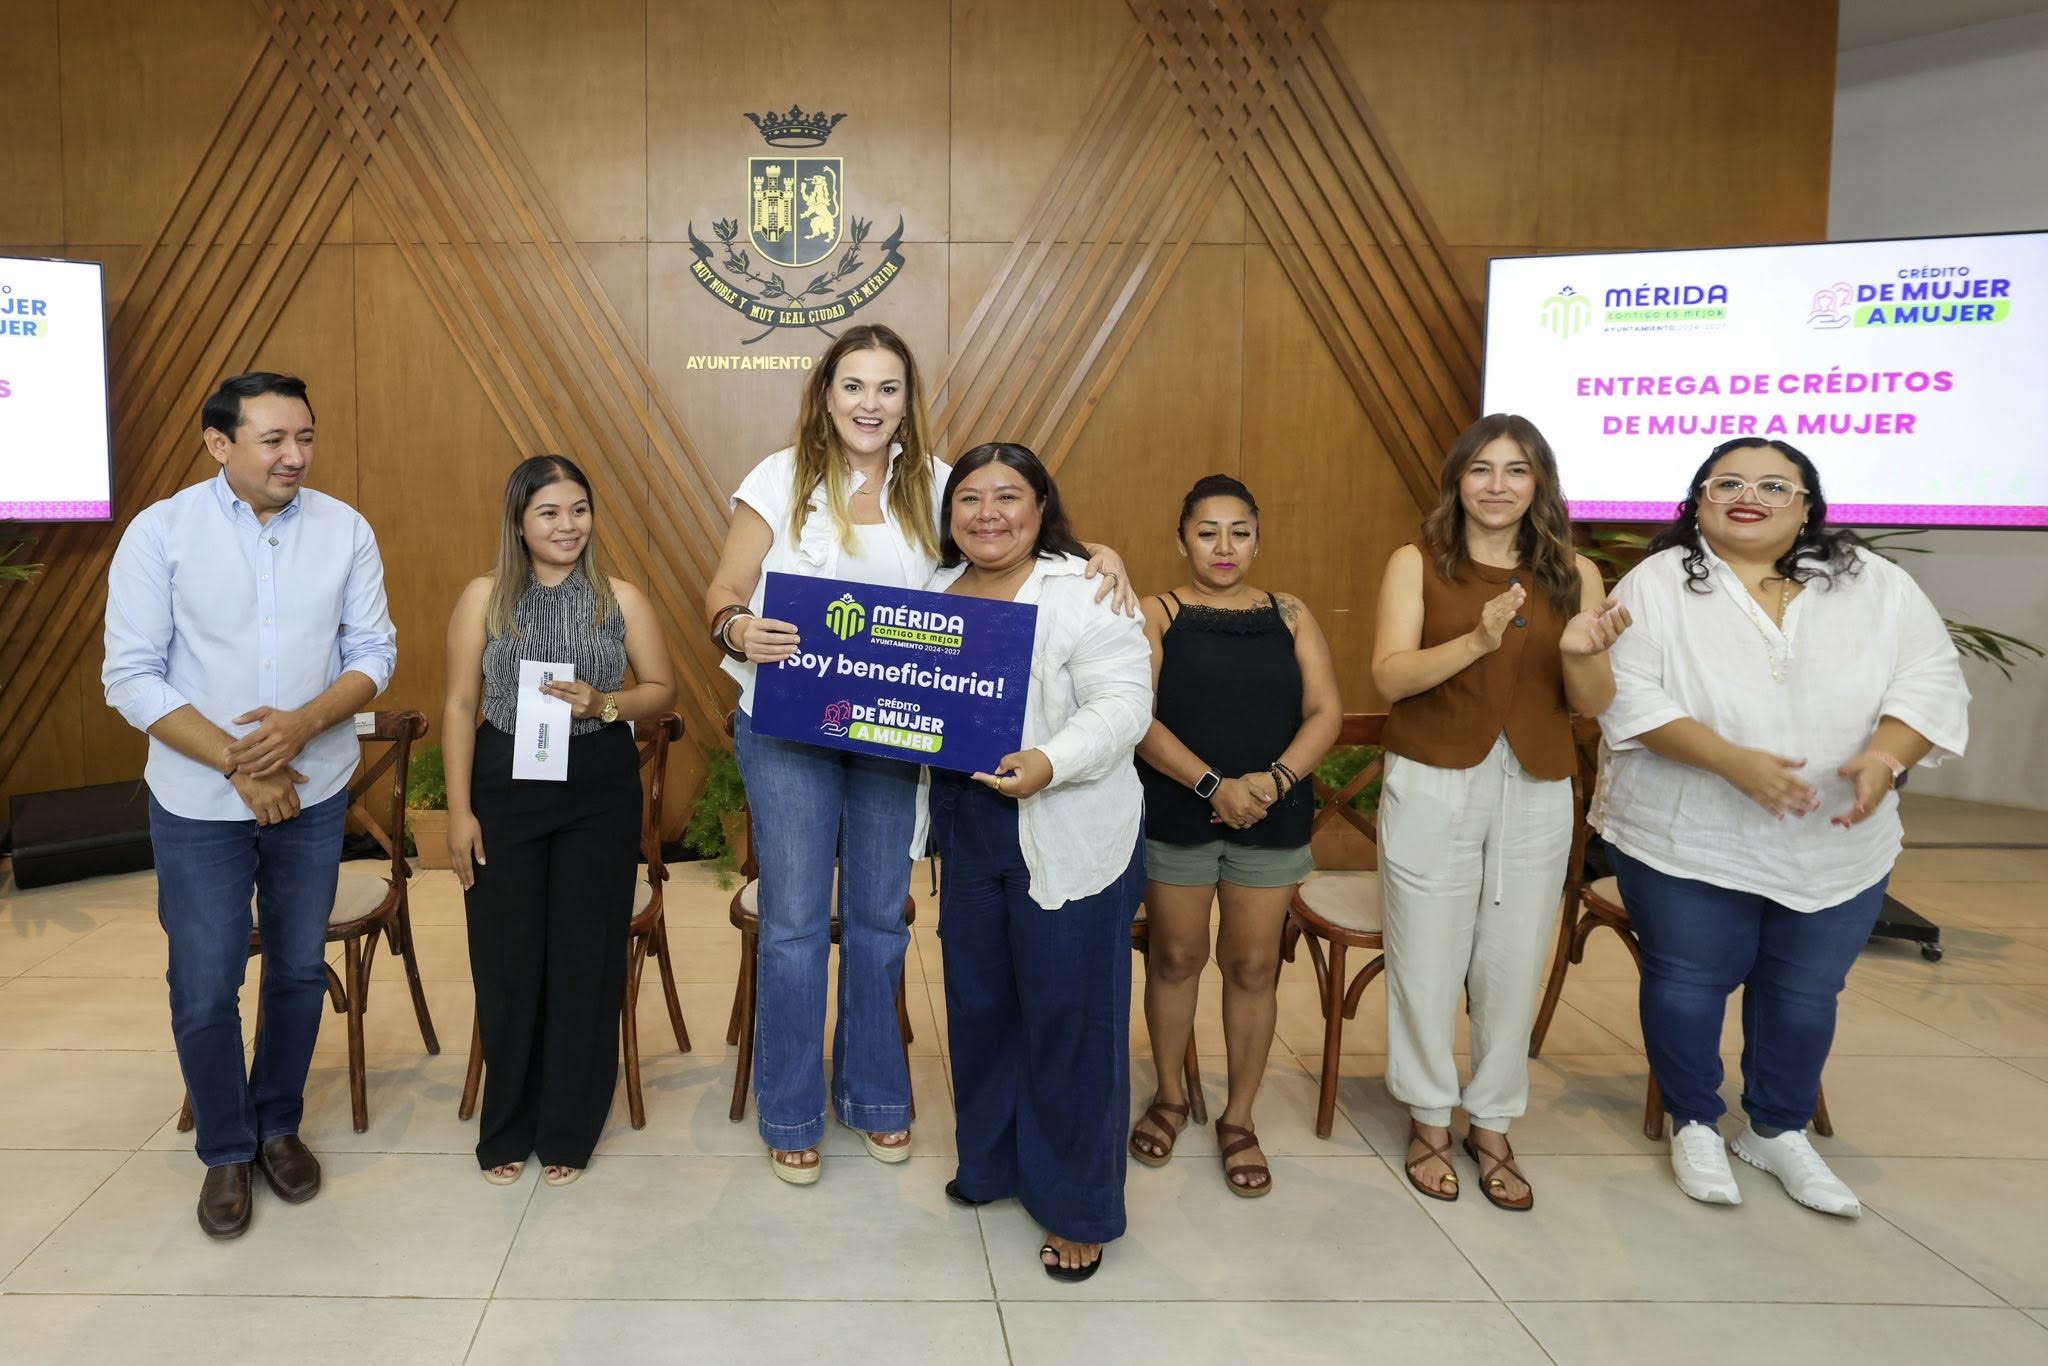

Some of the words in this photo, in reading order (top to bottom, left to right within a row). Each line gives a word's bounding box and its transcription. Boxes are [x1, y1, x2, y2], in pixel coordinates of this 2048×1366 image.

[1898, 266, 1970, 279] CRÉDITO
[692, 260, 714, 282] MUY
[709, 278, 738, 304] NOBLE
[738, 296, 748, 308] Y
[750, 305, 775, 322] MUY
[780, 311, 805, 324] LEAL
[808, 304, 846, 323] CIUDAD
[860, 262, 898, 297] MÉRIDA
[1605, 283, 1728, 307] MÉRIDA
[1857, 284, 1894, 302] DE
[1902, 279, 2010, 300] MUJER
[1867, 308, 1887, 324] A
[1894, 304, 1995, 323] MUJER
[686, 356, 812, 370] AYUNTAMIENTO
[1576, 376, 1720, 396] ENTREGA
[1730, 375, 1770, 394] DE
[1778, 366, 1954, 394] CRÉDITOS
[1603, 416, 1640, 434] DE
[1648, 415, 1757, 434] MUJER
[1765, 415, 1788, 434] A
[1797, 414, 1917, 434] MUJER
[872, 605, 964, 634] MÉRIDA
[870, 638, 924, 650] AYUNTAMIENTO
[925, 646, 960, 655] 2024-2027
[874, 627, 913, 638] CONTIGO
[930, 635, 959, 645] MEJOR
[837, 653, 1005, 699] beneficiaria!
[878, 698, 920, 712] CRÉDITO
[852, 704, 876, 722] DE
[878, 709, 944, 734] MUJER
[856, 726, 870, 739] A
[873, 727, 934, 750] MUJER
